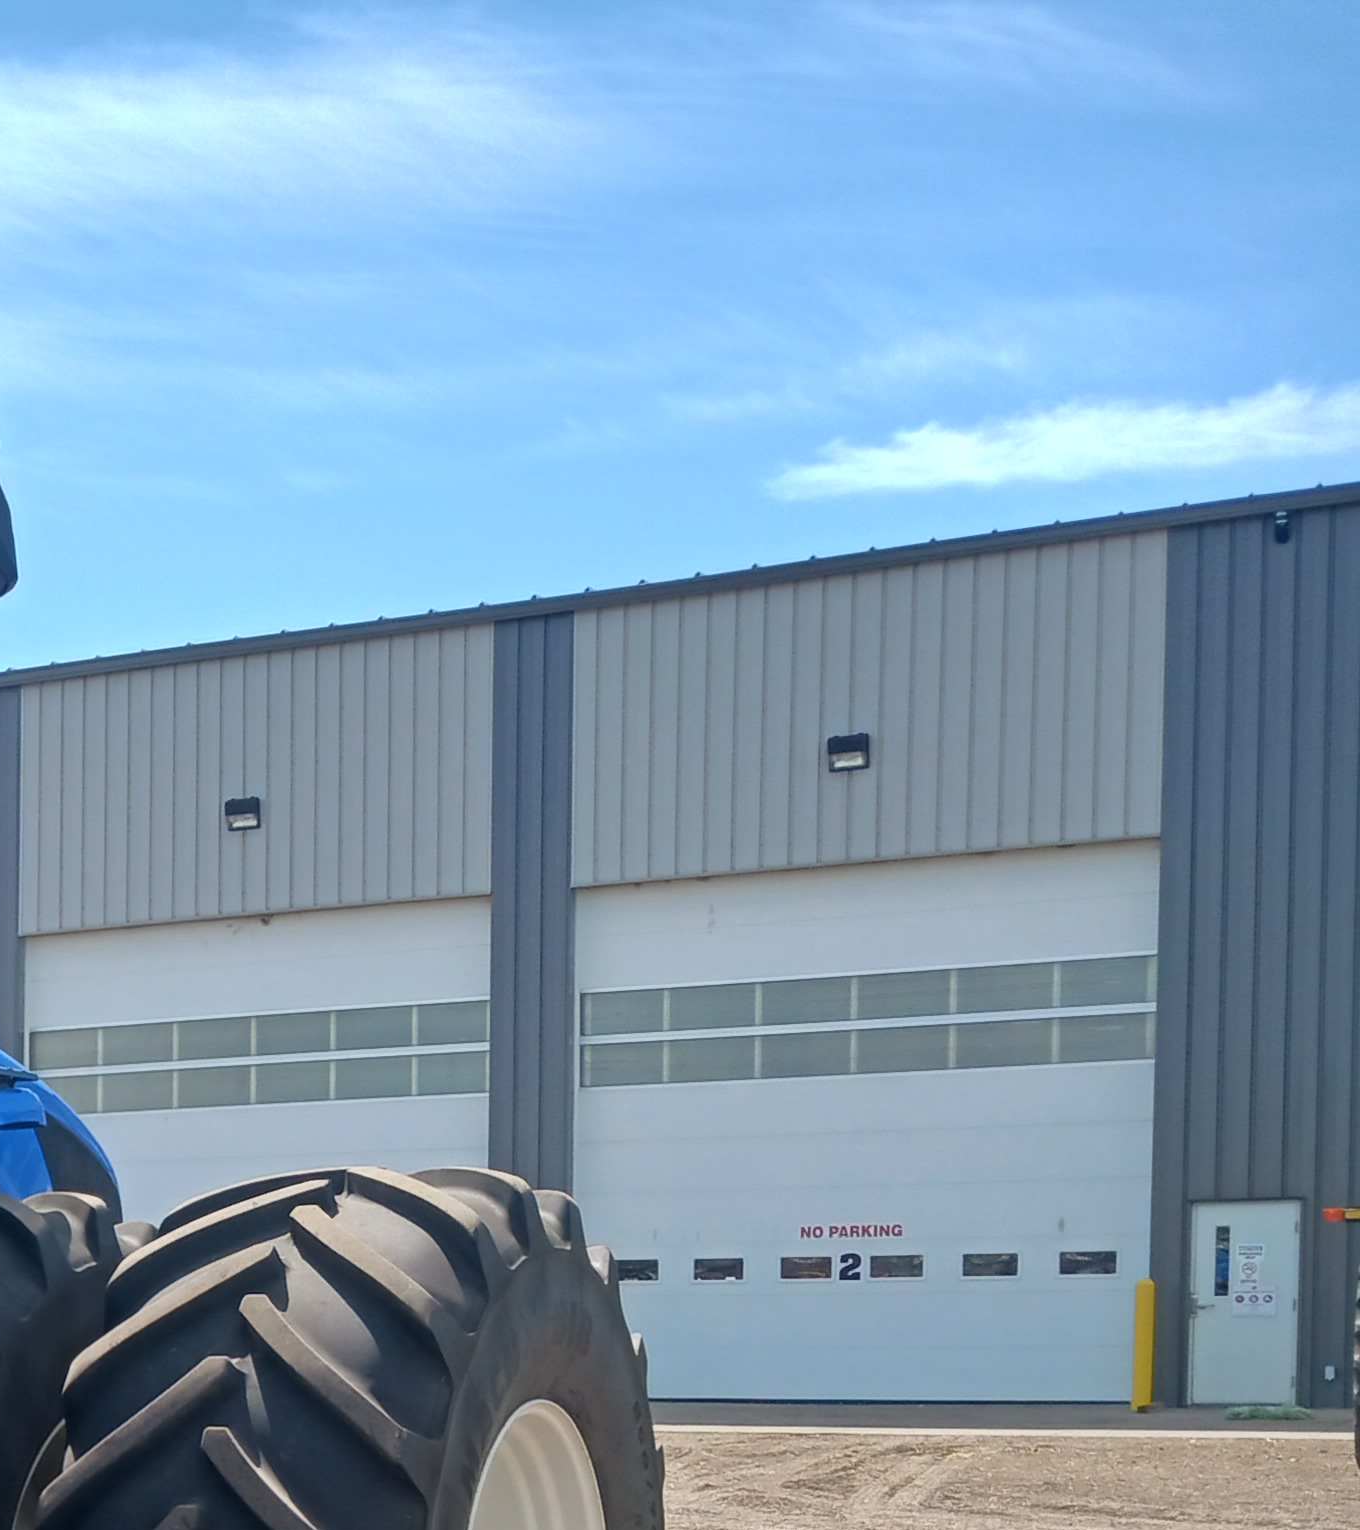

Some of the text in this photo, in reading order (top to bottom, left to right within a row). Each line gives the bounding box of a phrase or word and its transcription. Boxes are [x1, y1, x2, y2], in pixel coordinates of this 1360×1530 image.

[800, 1224, 903, 1239] NO PARKING
[839, 1253, 861, 1280] 2
